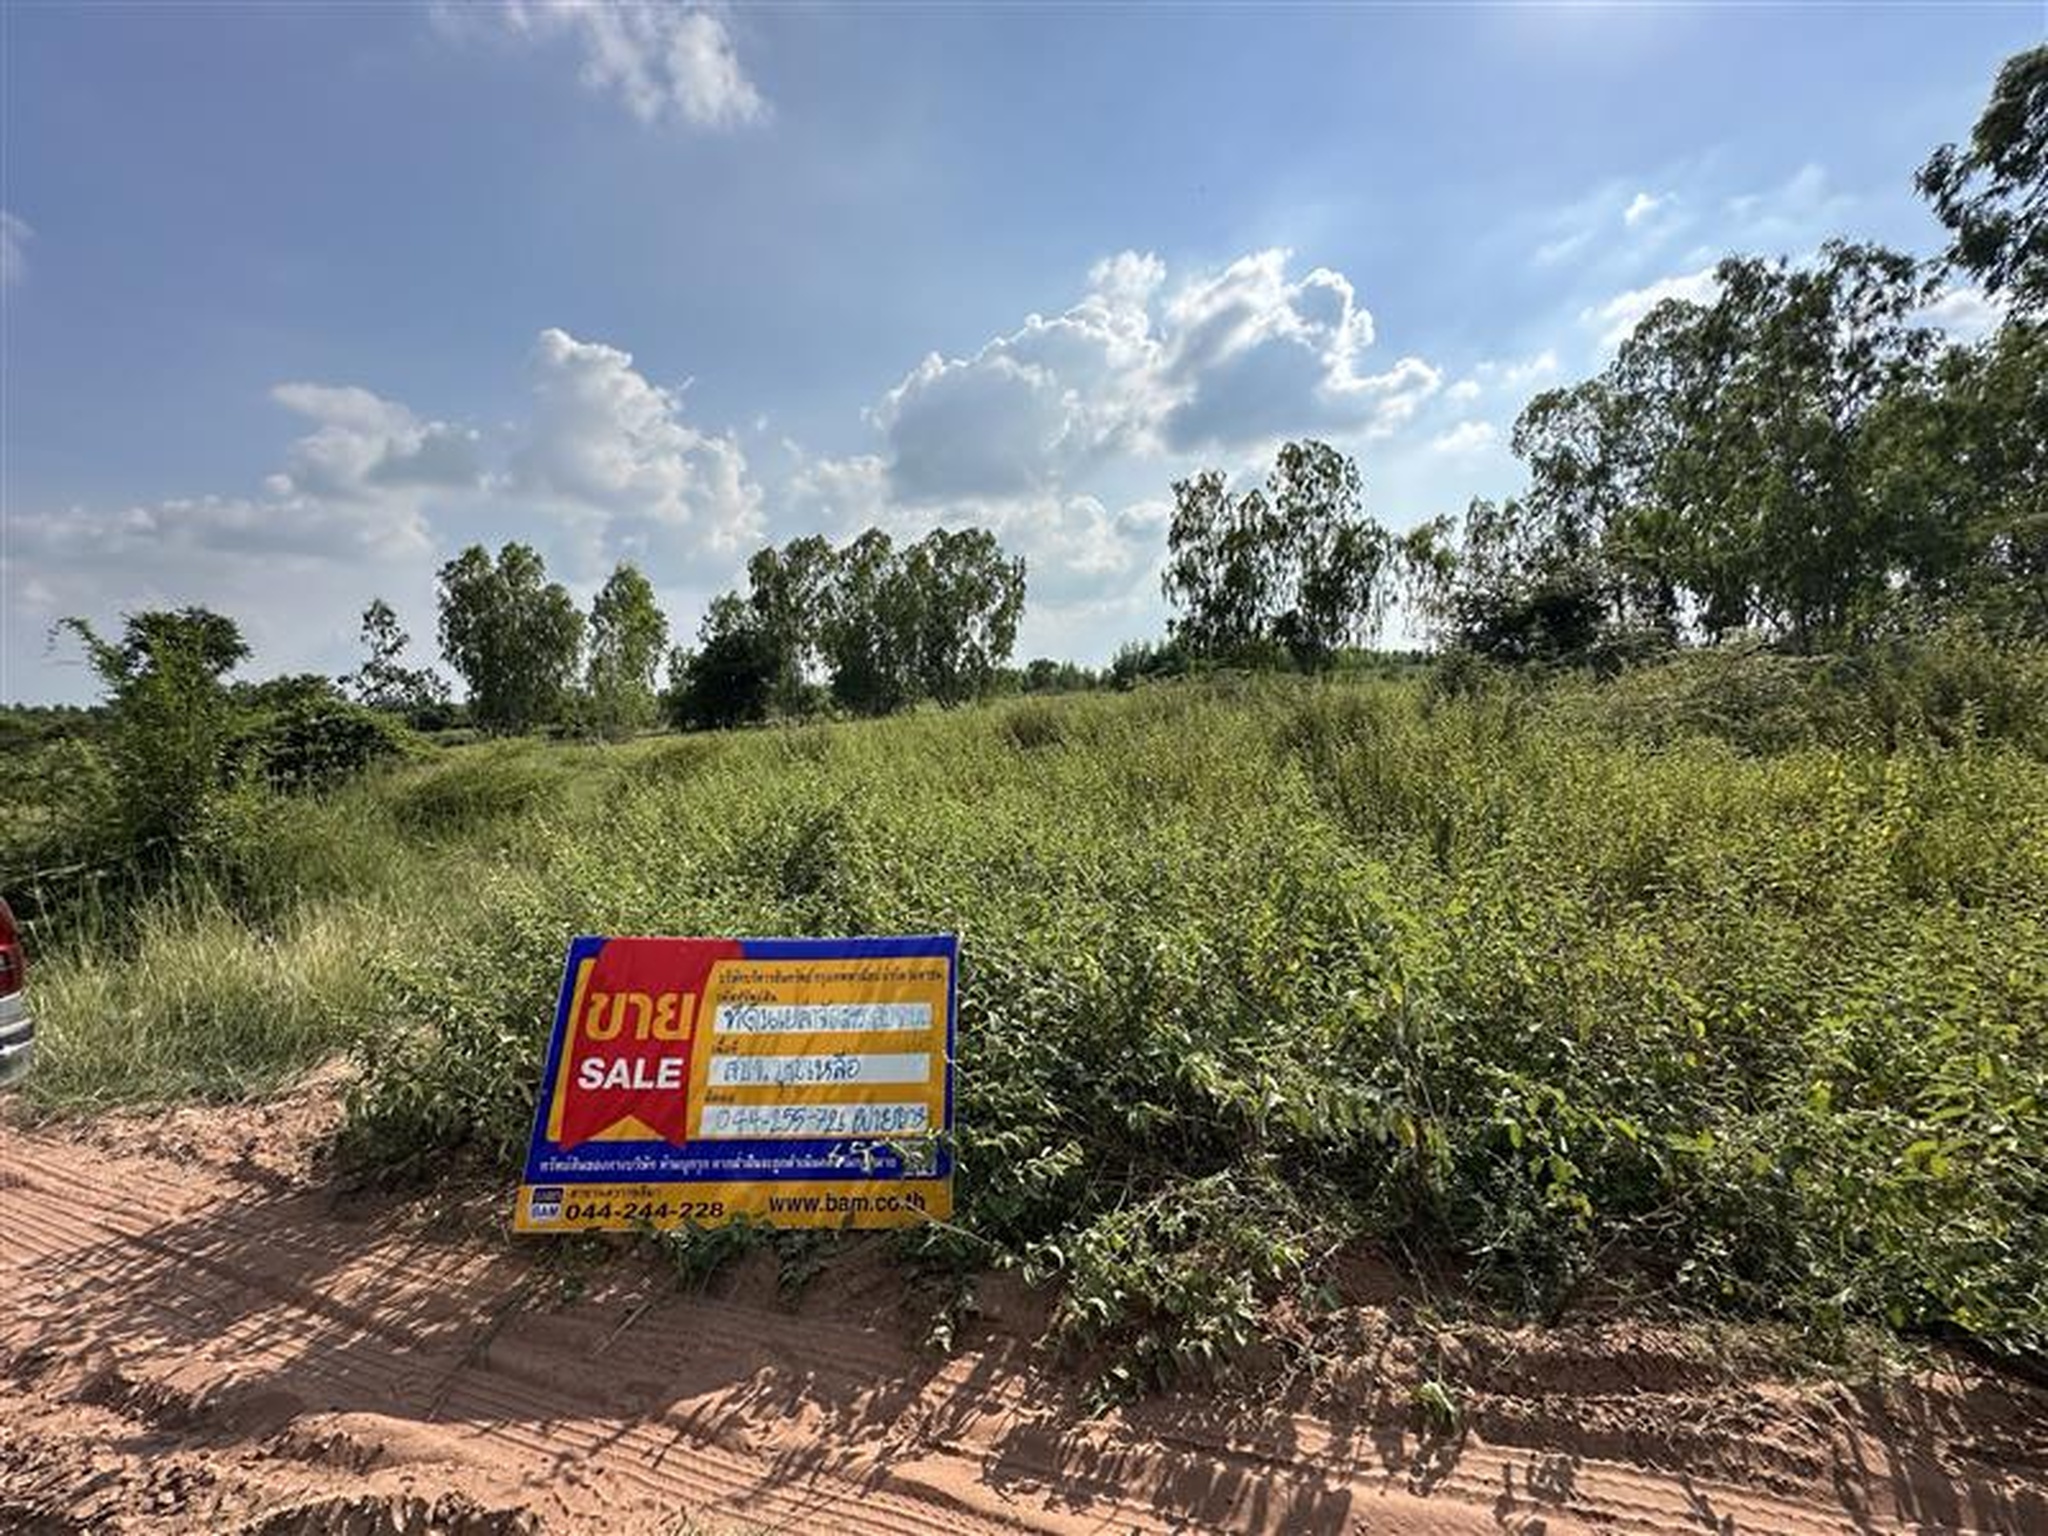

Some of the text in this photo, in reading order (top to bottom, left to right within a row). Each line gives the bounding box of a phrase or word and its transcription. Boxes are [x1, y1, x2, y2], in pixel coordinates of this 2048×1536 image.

[585, 992, 697, 1041] ขาย
[577, 1056, 684, 1090] SALE
[565, 1202, 725, 1222] 044-244-228
[769, 1191, 926, 1213] www.bam.co.th
